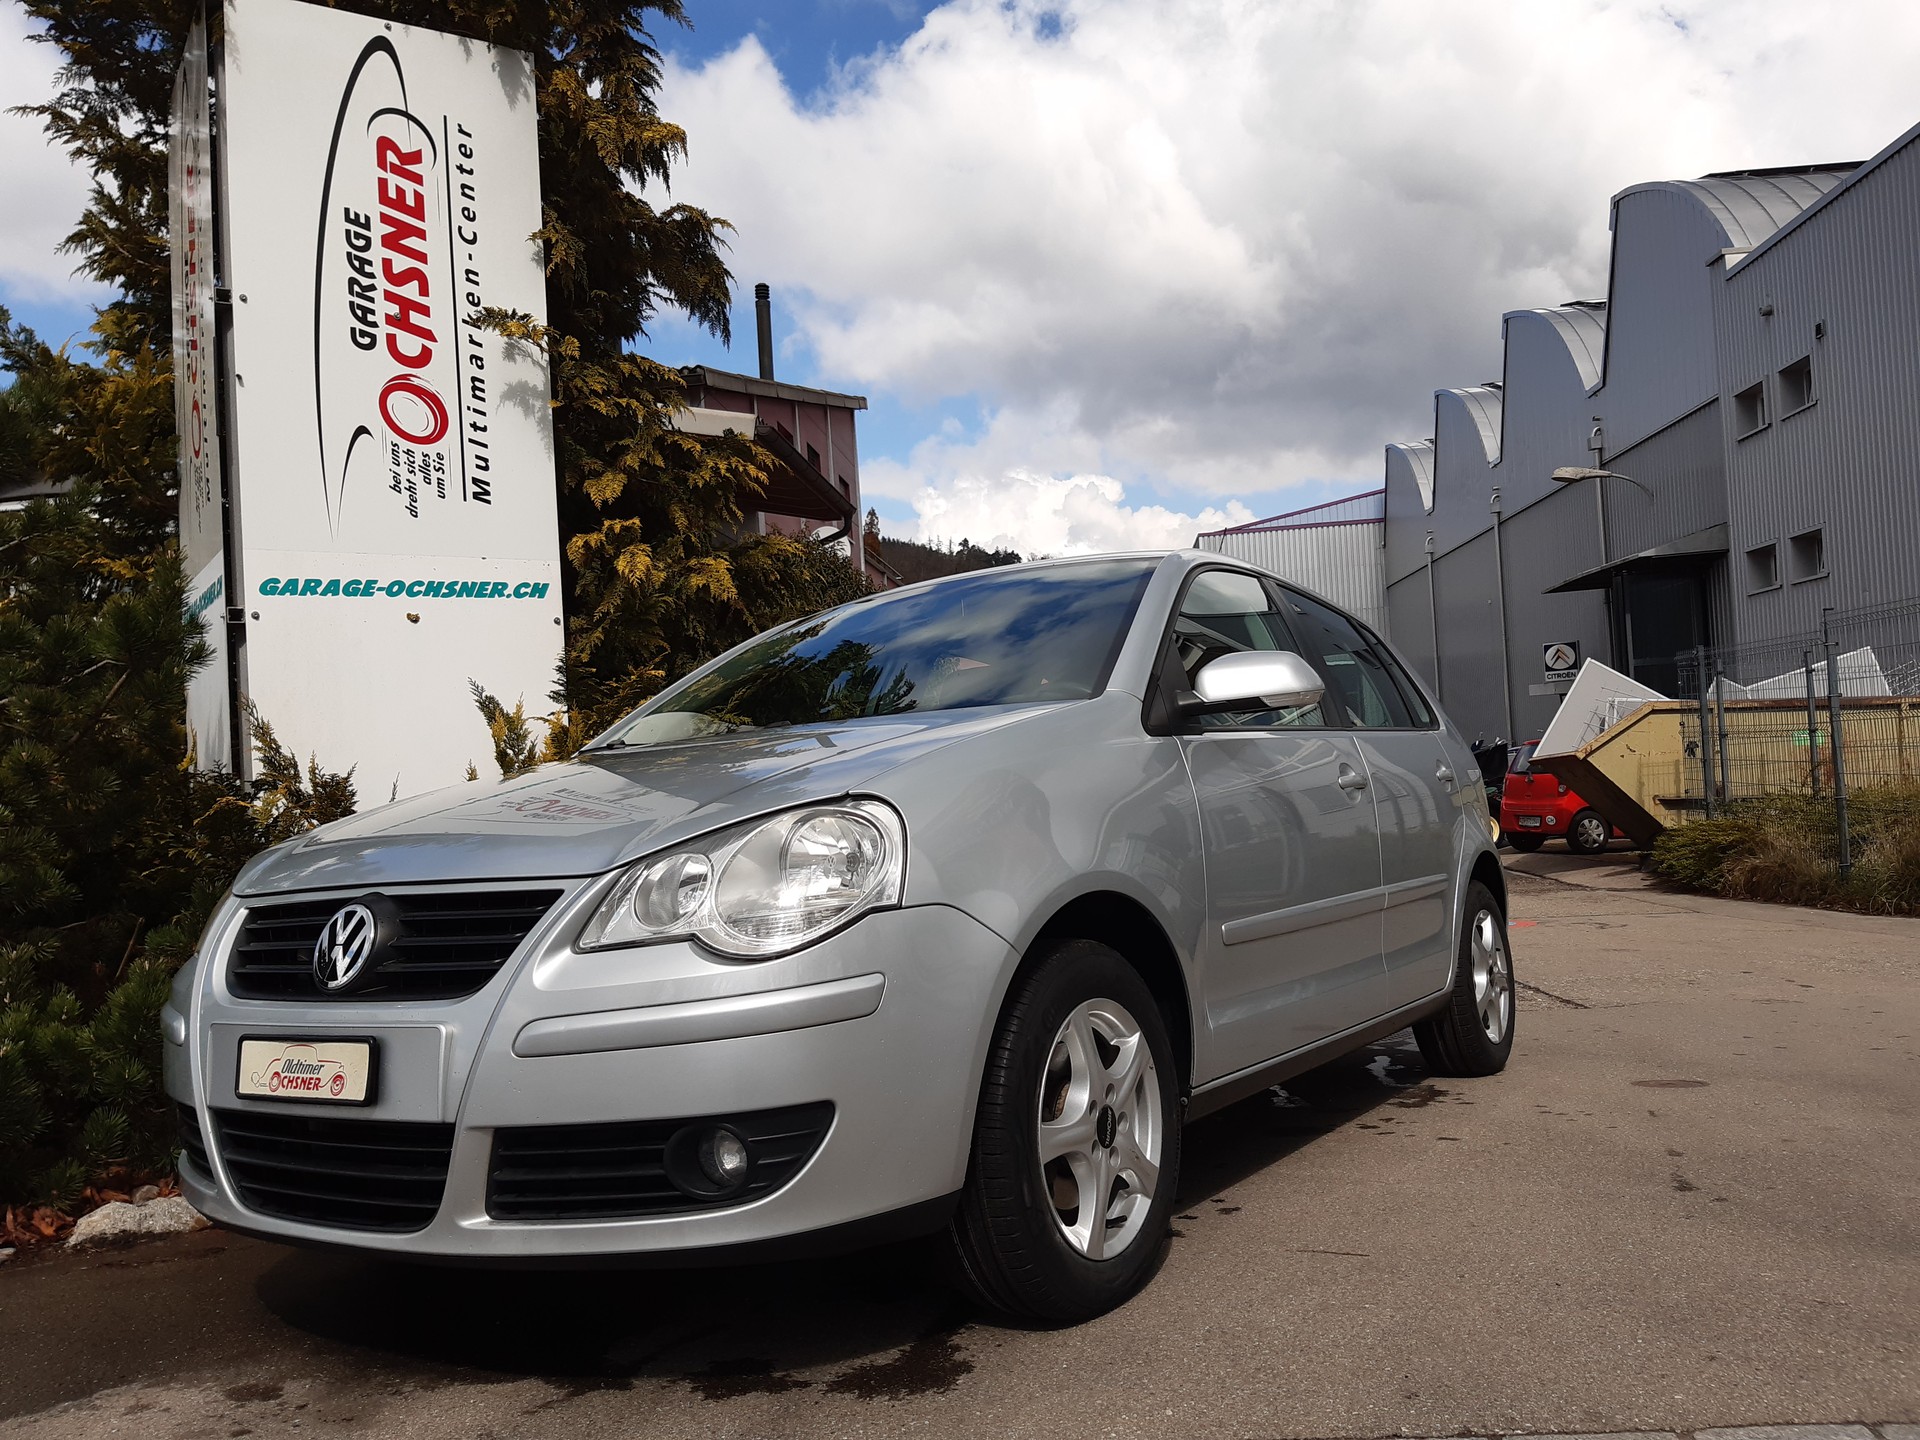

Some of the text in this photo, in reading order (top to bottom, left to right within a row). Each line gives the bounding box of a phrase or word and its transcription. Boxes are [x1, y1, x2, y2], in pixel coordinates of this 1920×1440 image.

[344, 207, 380, 352] GARAGE
[455, 123, 492, 505] Multimarken-Center
[389, 440, 402, 495] bei uns
[402, 448, 419, 519] dreht sich
[418, 451, 432, 485] alles
[432, 452, 446, 499] um Sie
[259, 577, 550, 599] GARAGE-OCHSNER.CH
[281, 1059, 325, 1076] Oldtimer
